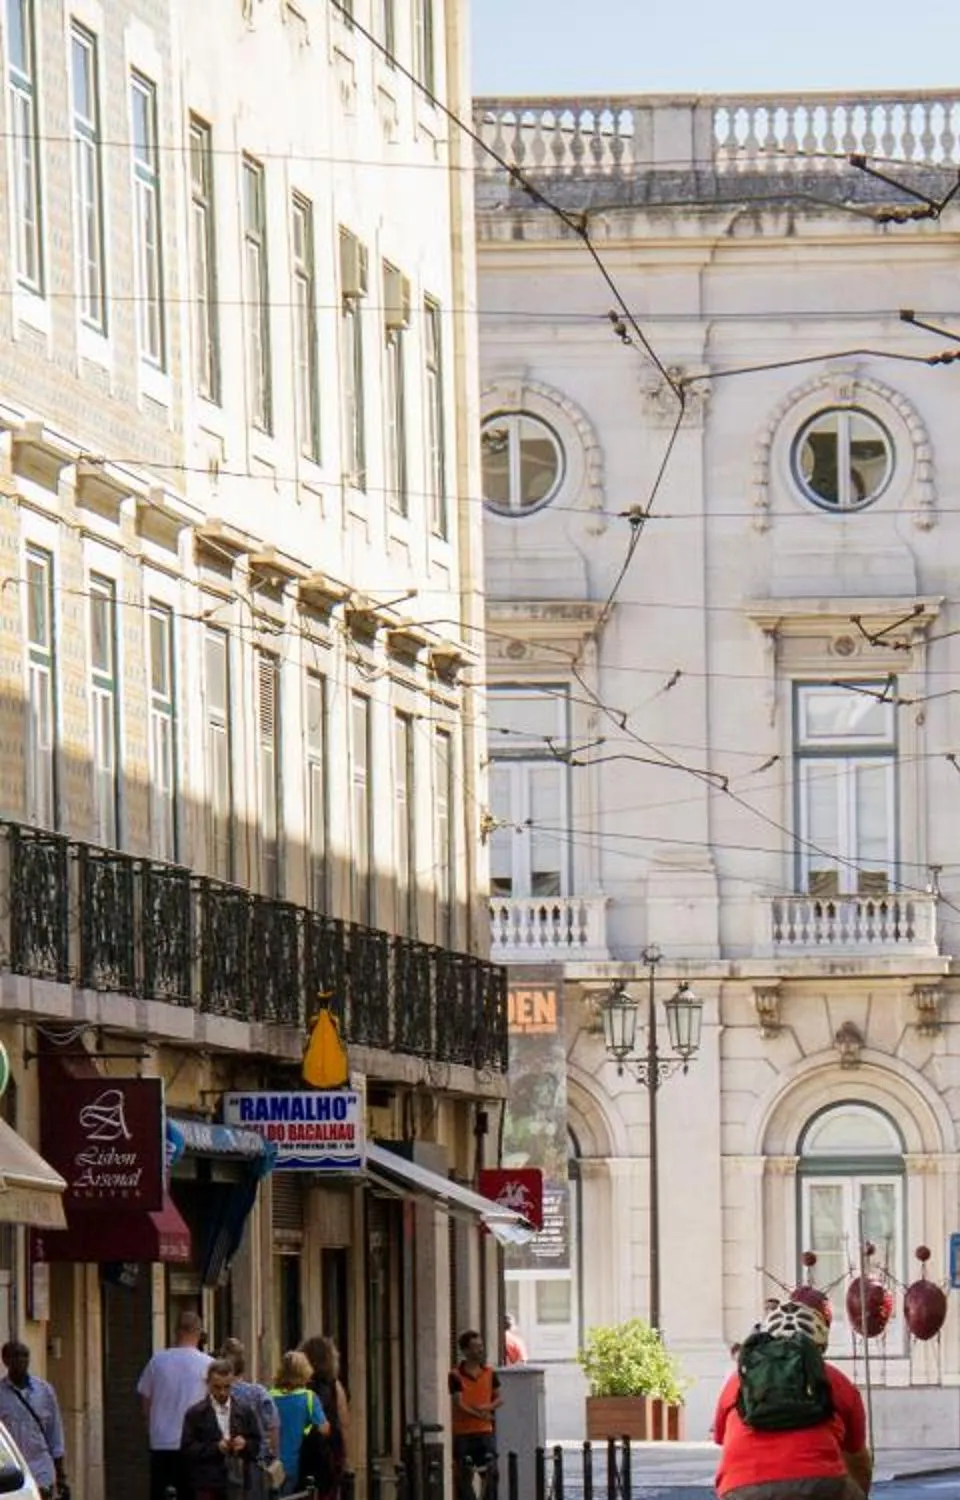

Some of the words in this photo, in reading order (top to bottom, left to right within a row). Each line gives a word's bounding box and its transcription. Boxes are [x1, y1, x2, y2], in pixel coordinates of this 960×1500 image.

[267, 1124, 285, 1140] DO
[287, 1123, 355, 1141] BACALHAU
[75, 1145, 137, 1167] Lisbon
[72, 1167, 144, 1187] Arsenal
